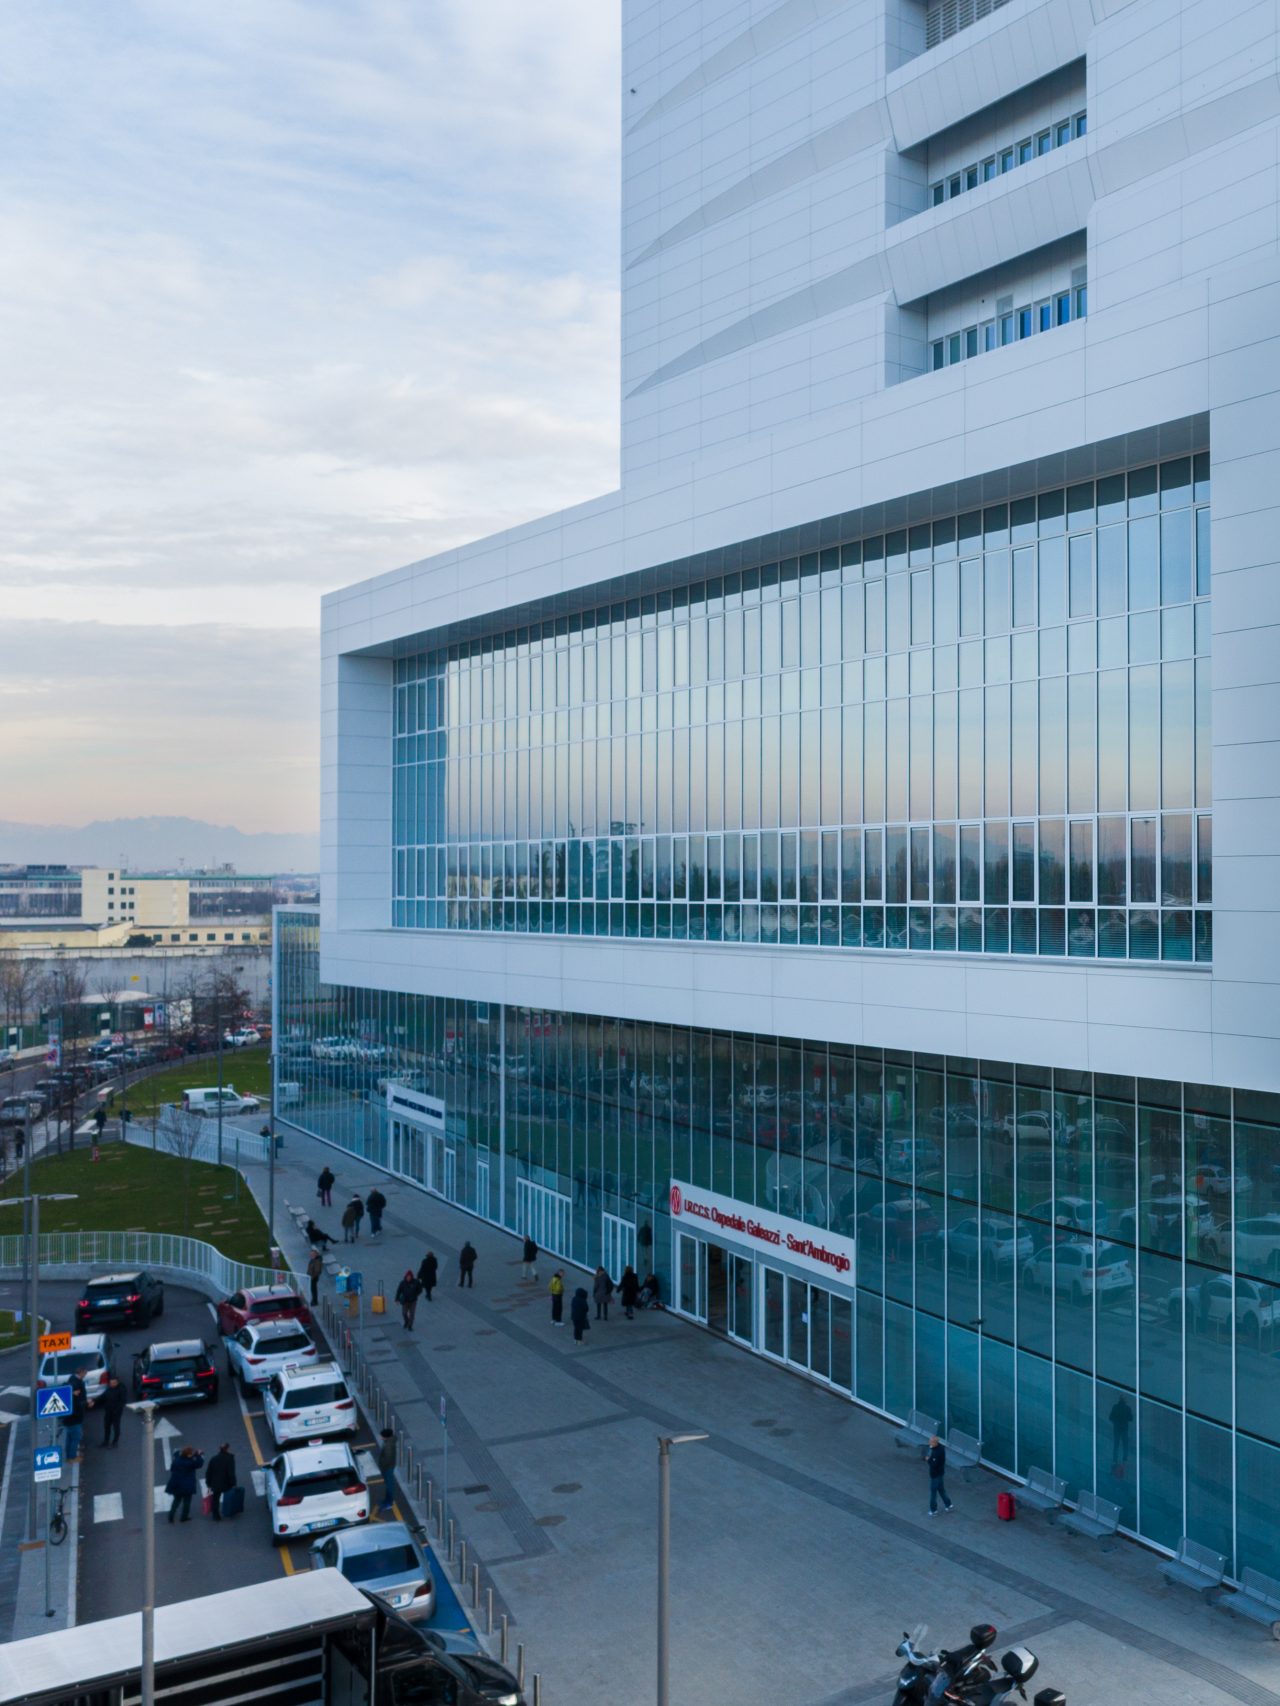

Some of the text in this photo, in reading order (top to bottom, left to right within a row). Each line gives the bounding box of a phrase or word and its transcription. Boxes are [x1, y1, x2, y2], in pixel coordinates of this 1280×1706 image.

[711, 1207, 746, 1232] Ospedale
[747, 1219, 780, 1246] Galeazzi
[787, 1233, 851, 1273] Sant'Ambrogio
[42, 1337, 69, 1348] TAXI
